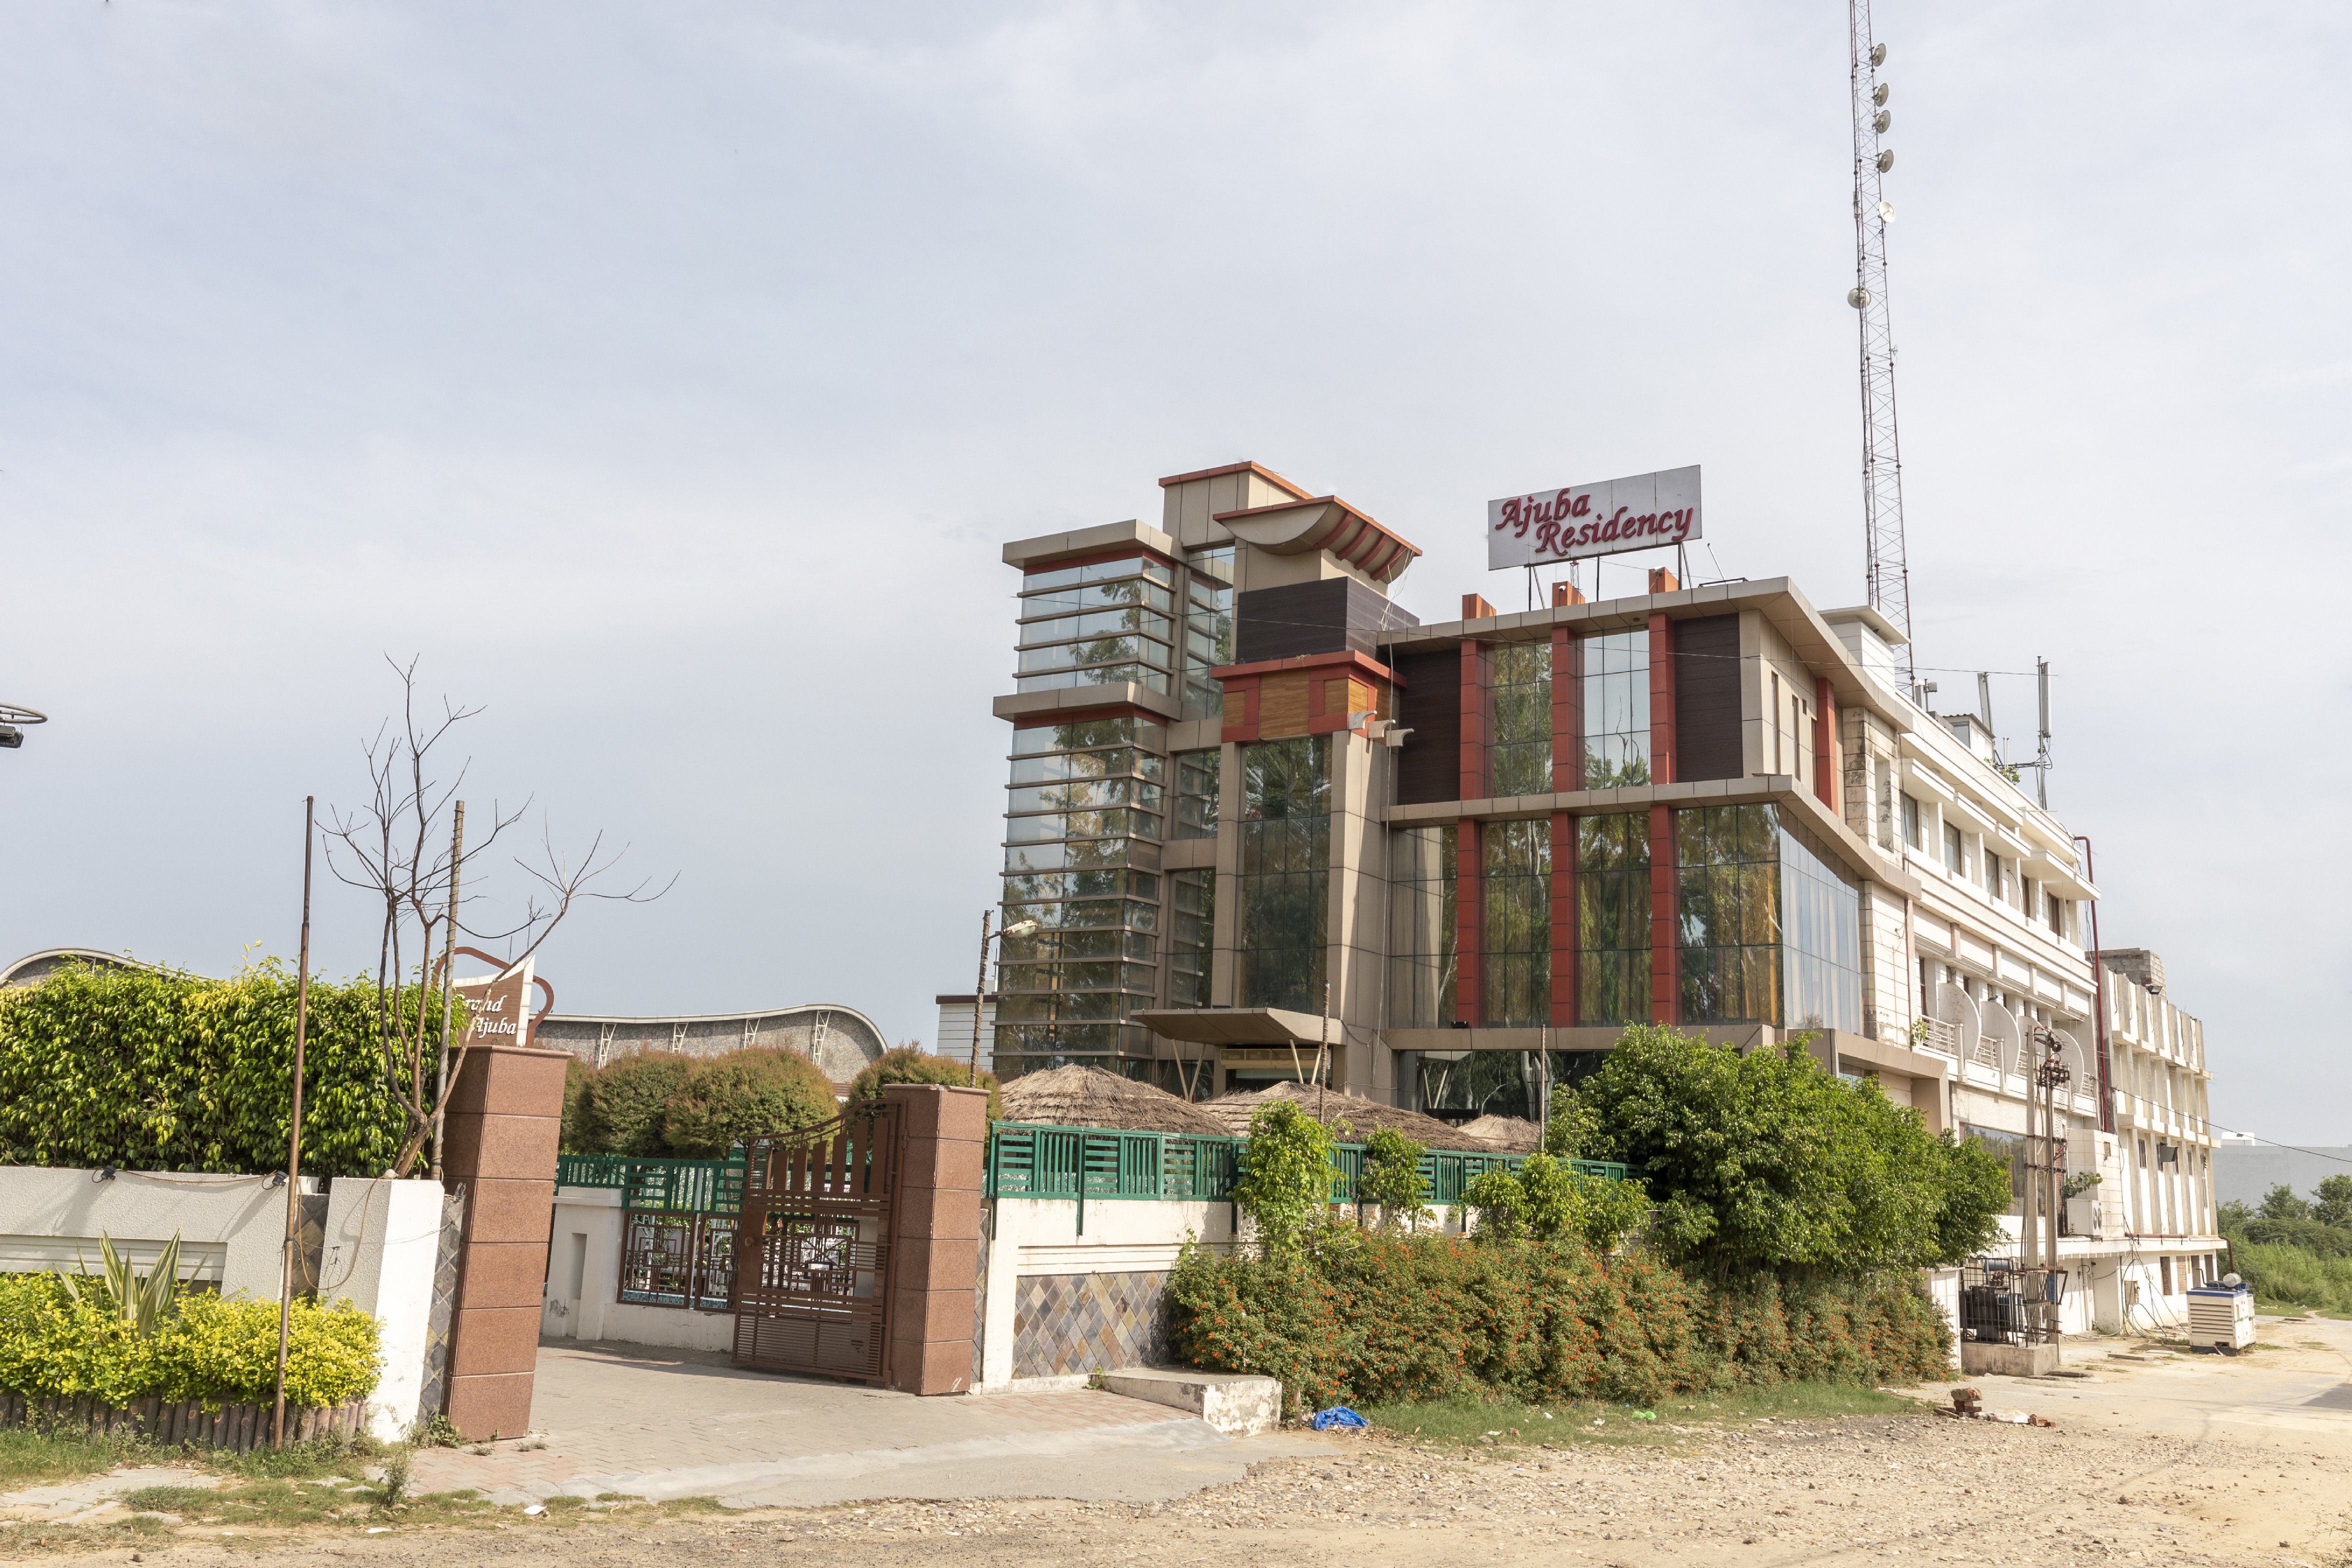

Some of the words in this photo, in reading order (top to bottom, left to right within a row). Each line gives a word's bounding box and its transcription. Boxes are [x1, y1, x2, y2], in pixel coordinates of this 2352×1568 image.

[1495, 488, 1590, 538] Ajuba
[1535, 506, 1693, 556] Residency
[457, 994, 508, 1012] rand
[472, 1017, 517, 1038] Ajuba
